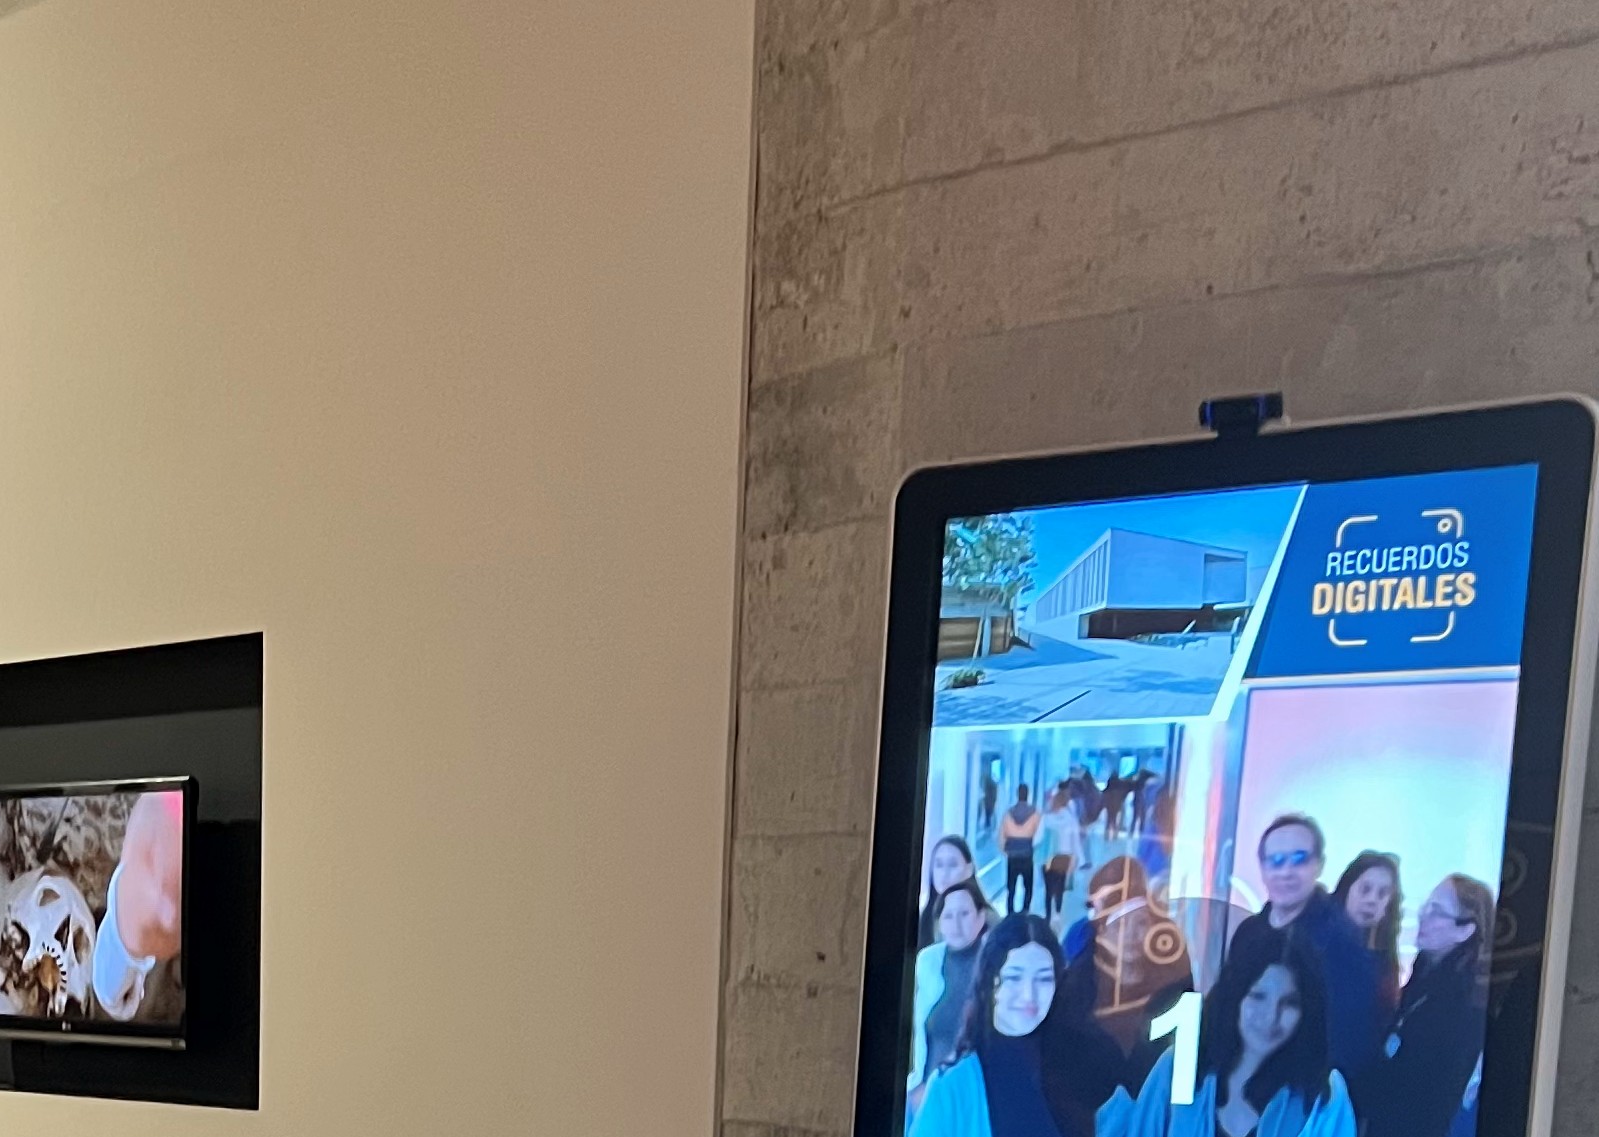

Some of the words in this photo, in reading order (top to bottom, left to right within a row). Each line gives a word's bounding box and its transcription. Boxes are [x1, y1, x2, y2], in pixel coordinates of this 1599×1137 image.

[1326, 541, 1470, 577] RECUERDOS
[1311, 572, 1477, 616] DIGITALES
[1149, 991, 1202, 1105] 1
